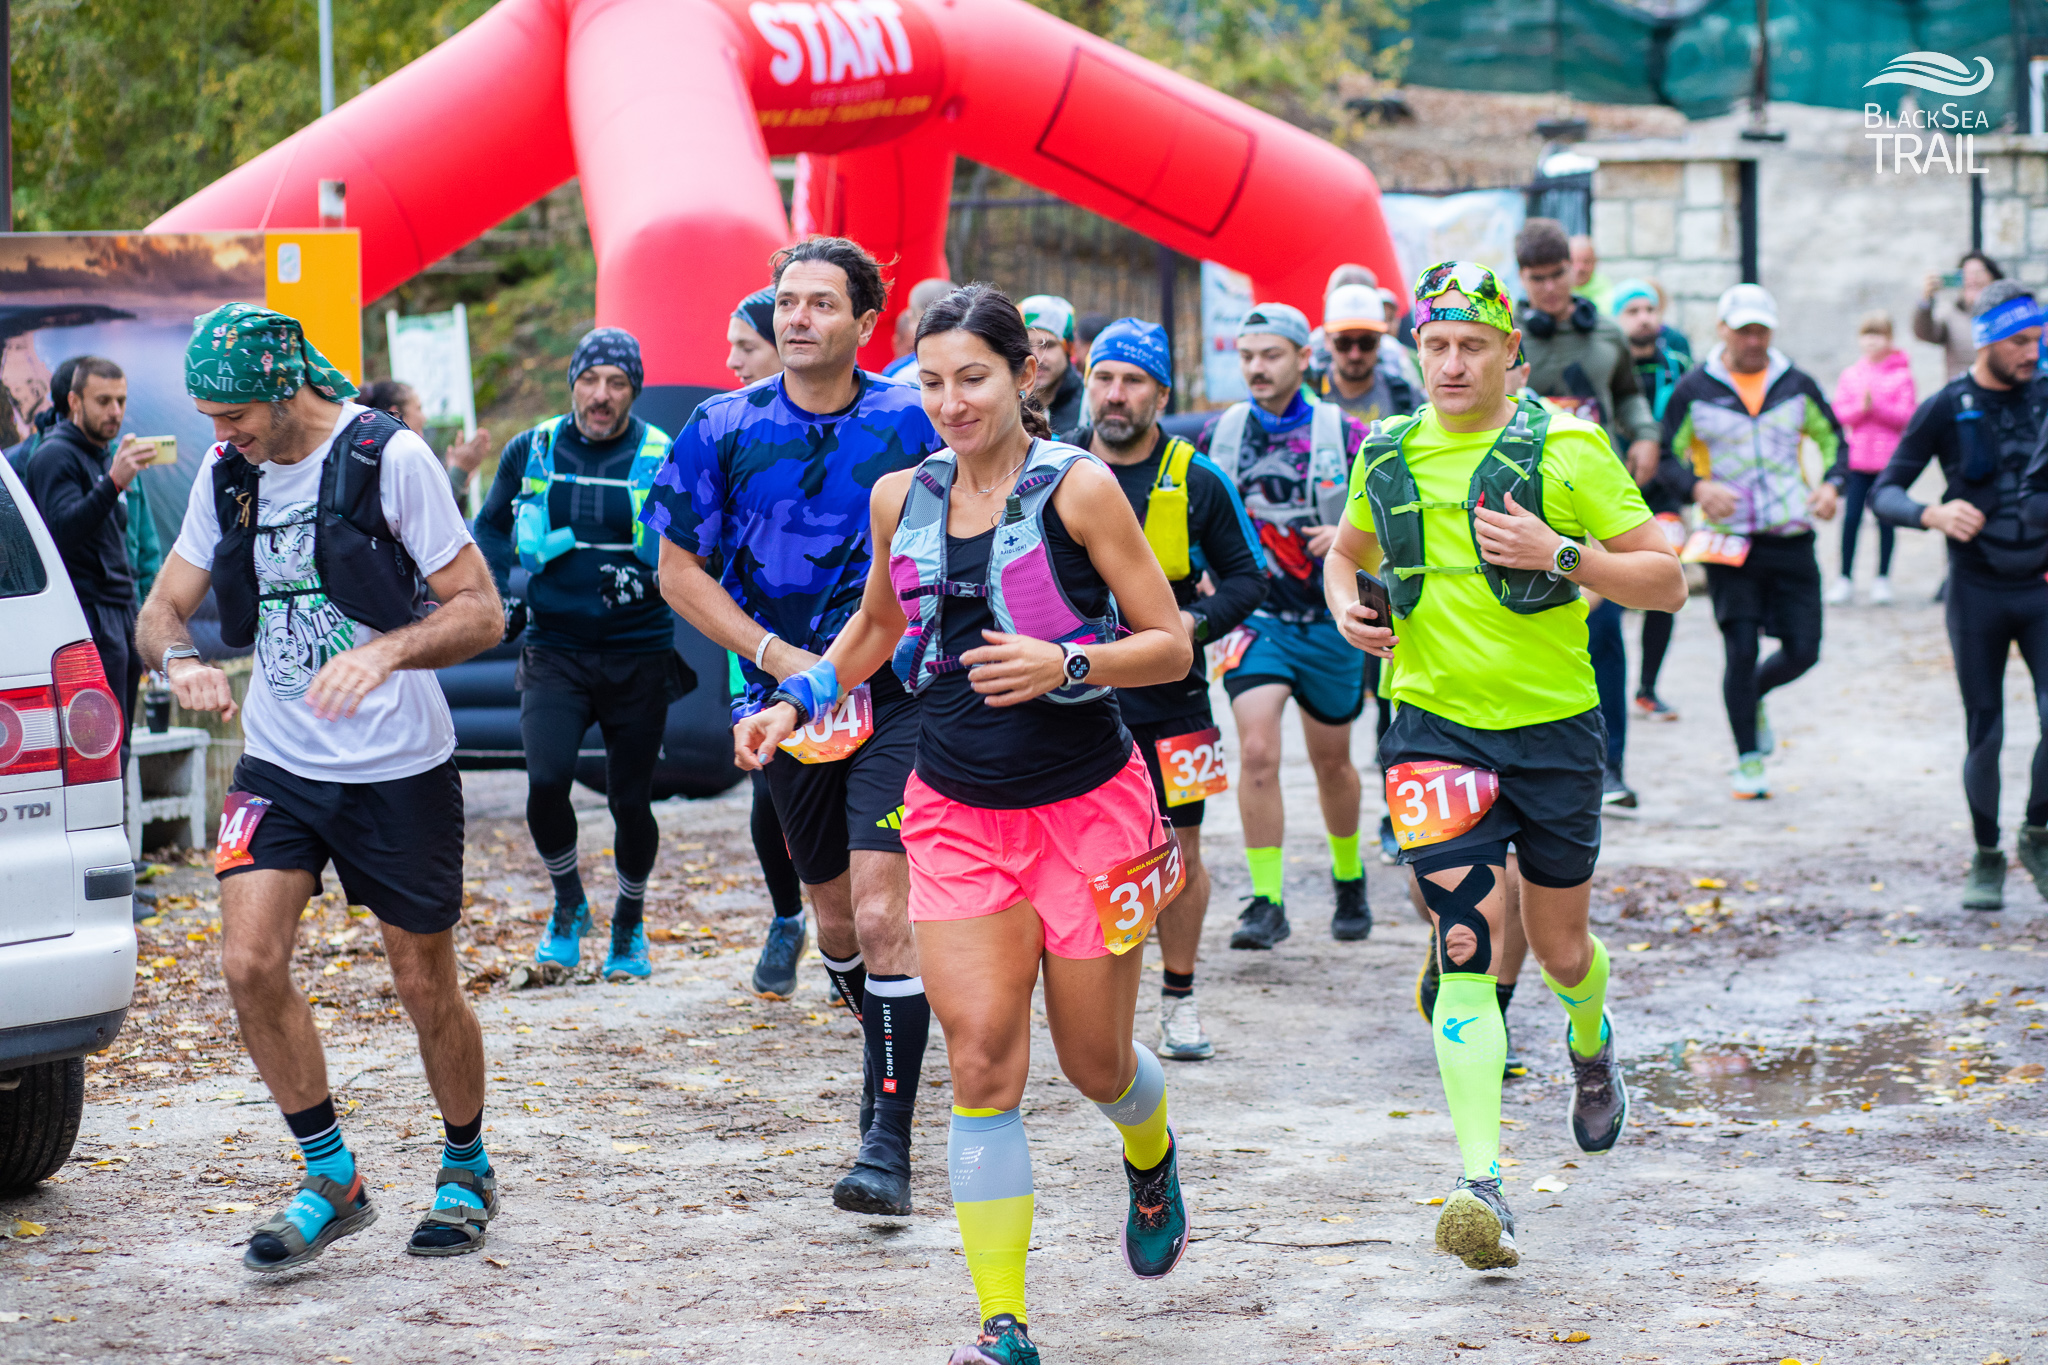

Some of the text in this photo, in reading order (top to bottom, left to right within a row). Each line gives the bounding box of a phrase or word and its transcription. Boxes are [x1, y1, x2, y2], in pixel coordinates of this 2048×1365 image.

[748, 0, 914, 86] START
[187, 371, 267, 393] ONTICA
[1000, 543, 1027, 555] RAIDLIGHT
[1169, 740, 1227, 788] 325
[1410, 766, 1440, 776] LACHEZAR
[14, 802, 51, 820] TDI
[1396, 770, 1481, 827] 311
[1126, 849, 1170, 876] MARIA NASHEVA
[1109, 845, 1180, 931] 313
[883, 1003, 894, 1077] COMPRESSPORT
